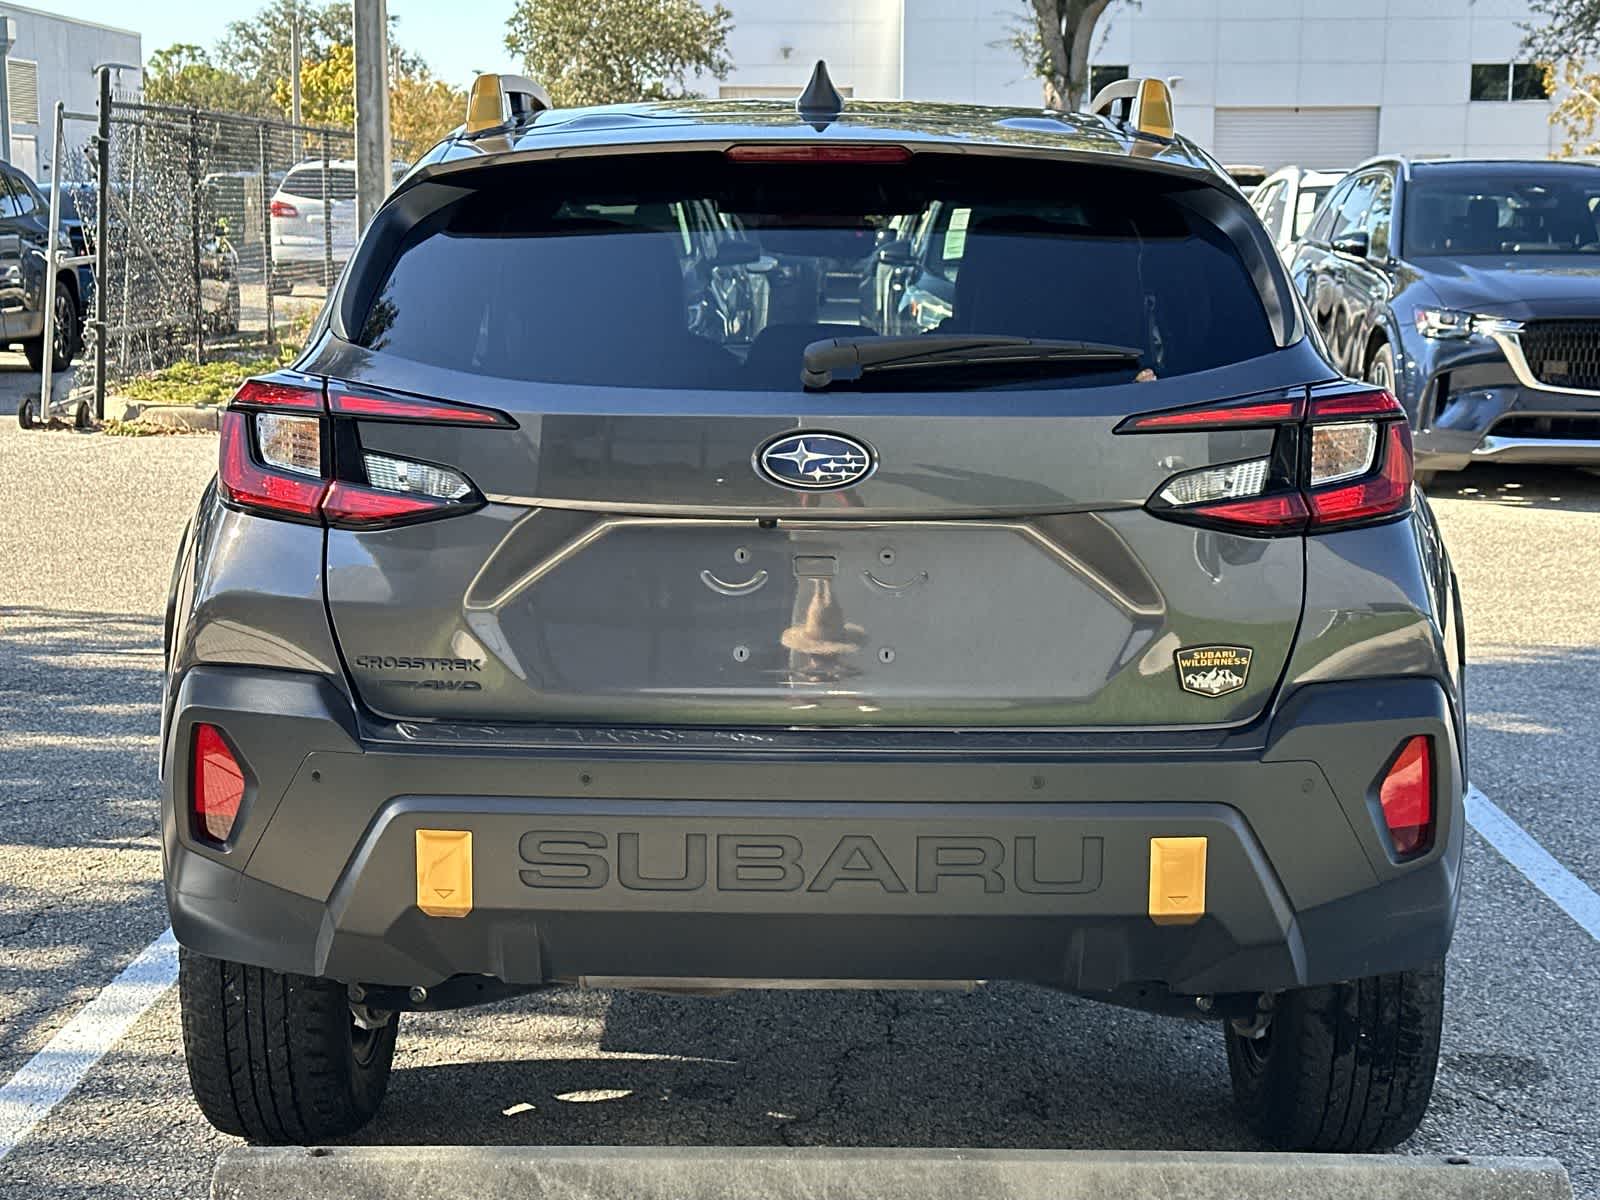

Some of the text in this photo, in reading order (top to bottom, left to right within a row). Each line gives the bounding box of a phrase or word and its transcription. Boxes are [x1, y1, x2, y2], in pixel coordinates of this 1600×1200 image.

[1193, 650, 1236, 659] SUBARU
[356, 655, 481, 671] CROSSTREK
[1181, 657, 1248, 667] WILDERNESS
[417, 680, 482, 690] AWD
[519, 830, 1104, 894] SUBARU
